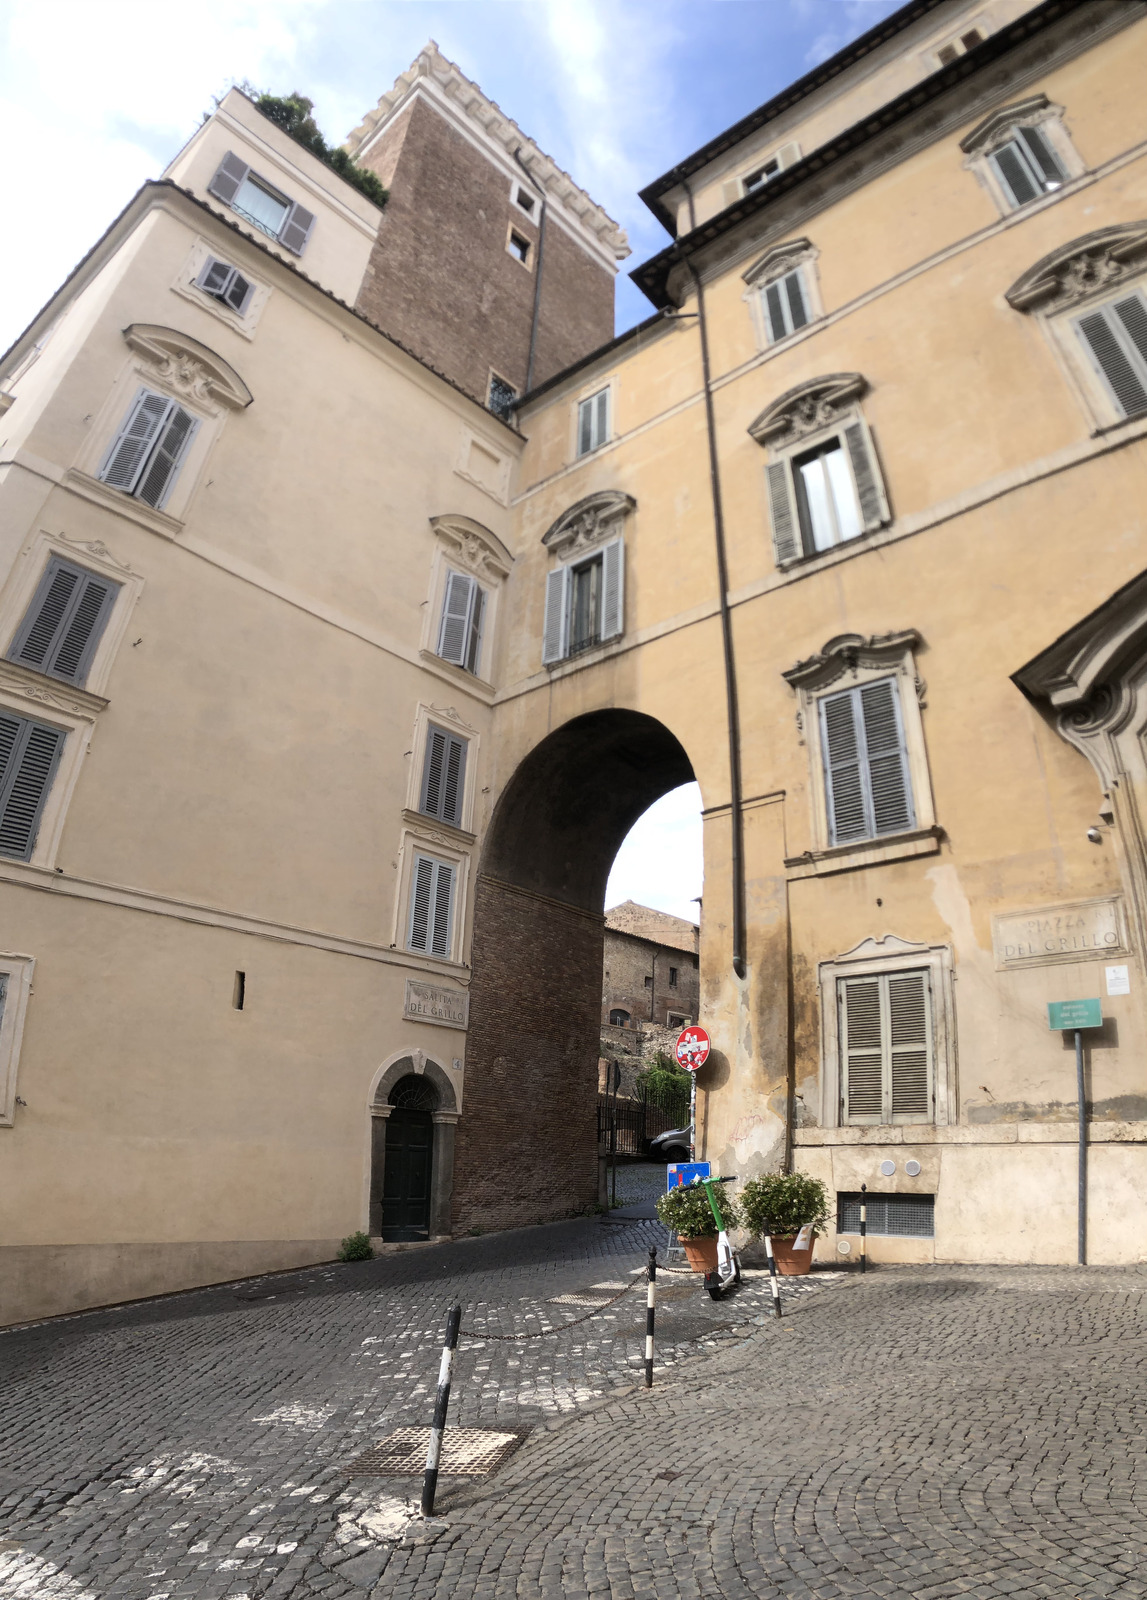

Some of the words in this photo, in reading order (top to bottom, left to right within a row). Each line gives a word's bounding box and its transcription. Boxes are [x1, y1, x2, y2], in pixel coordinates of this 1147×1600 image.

[1027, 915, 1086, 933] PIAZZA
[1004, 942, 1036, 957] DEL
[1044, 931, 1117, 951] GRILLO
[424, 991, 452, 1005] SALITA
[410, 1002, 427, 1014] DEL
[430, 1006, 464, 1020] GRILLO
